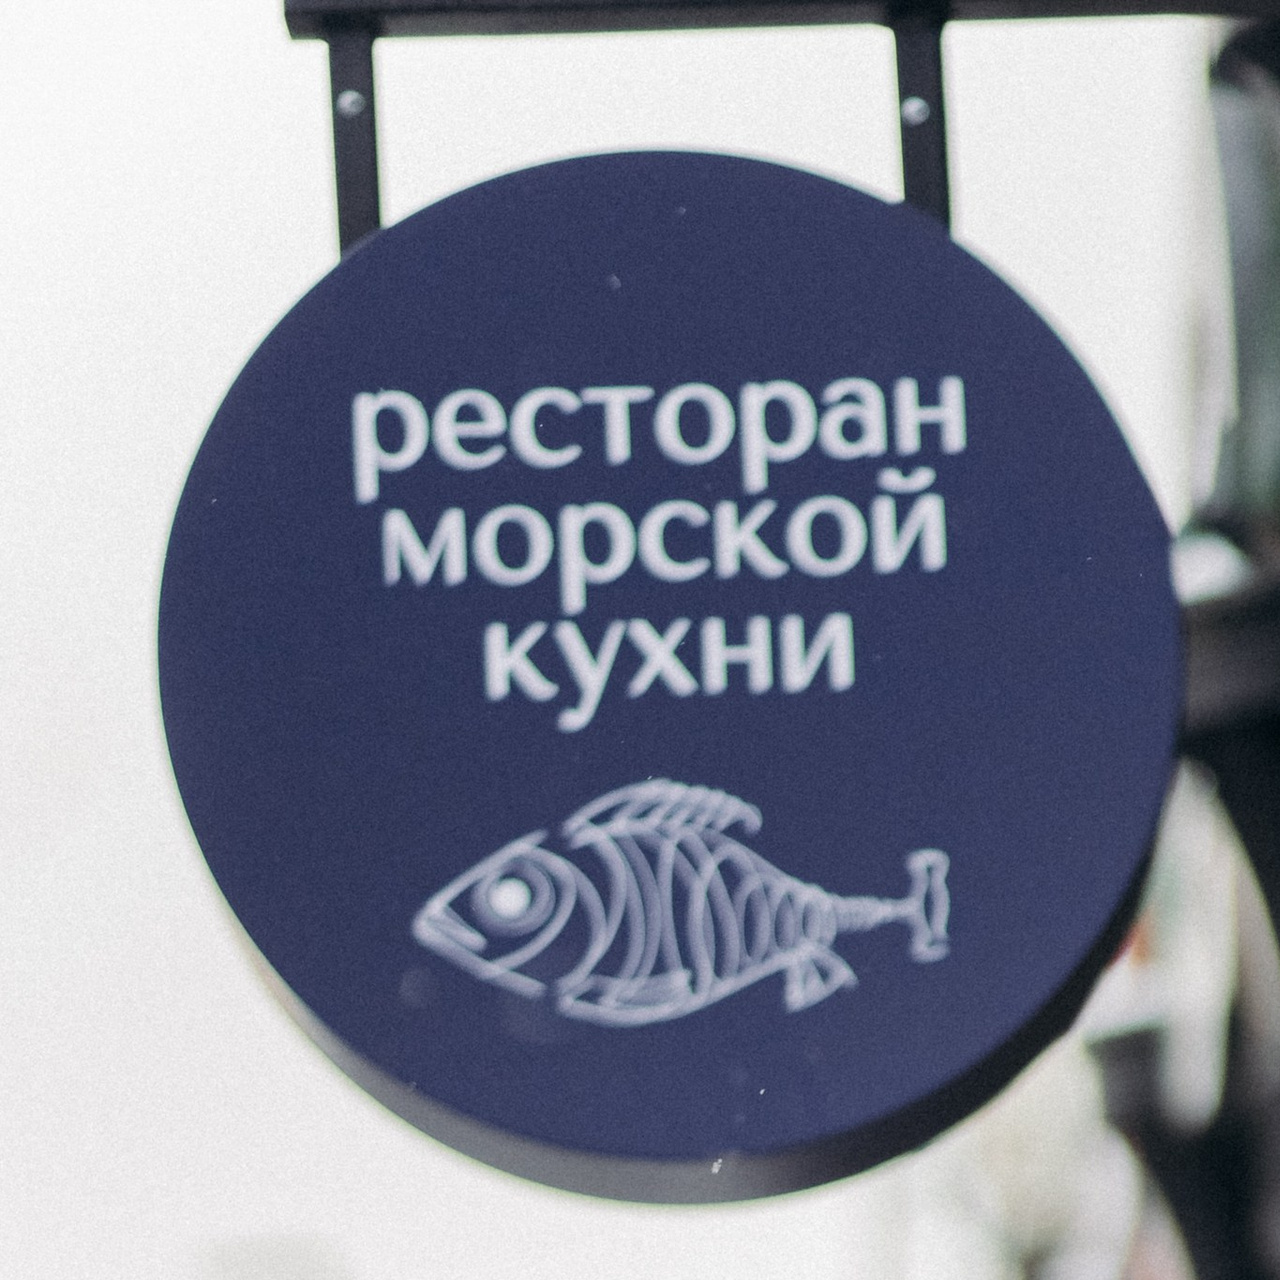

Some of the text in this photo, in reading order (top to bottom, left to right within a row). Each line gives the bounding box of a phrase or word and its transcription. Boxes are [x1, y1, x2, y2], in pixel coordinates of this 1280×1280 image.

[352, 375, 967, 503] ресторан
[382, 466, 948, 615] морской
[483, 612, 855, 732] кухни
